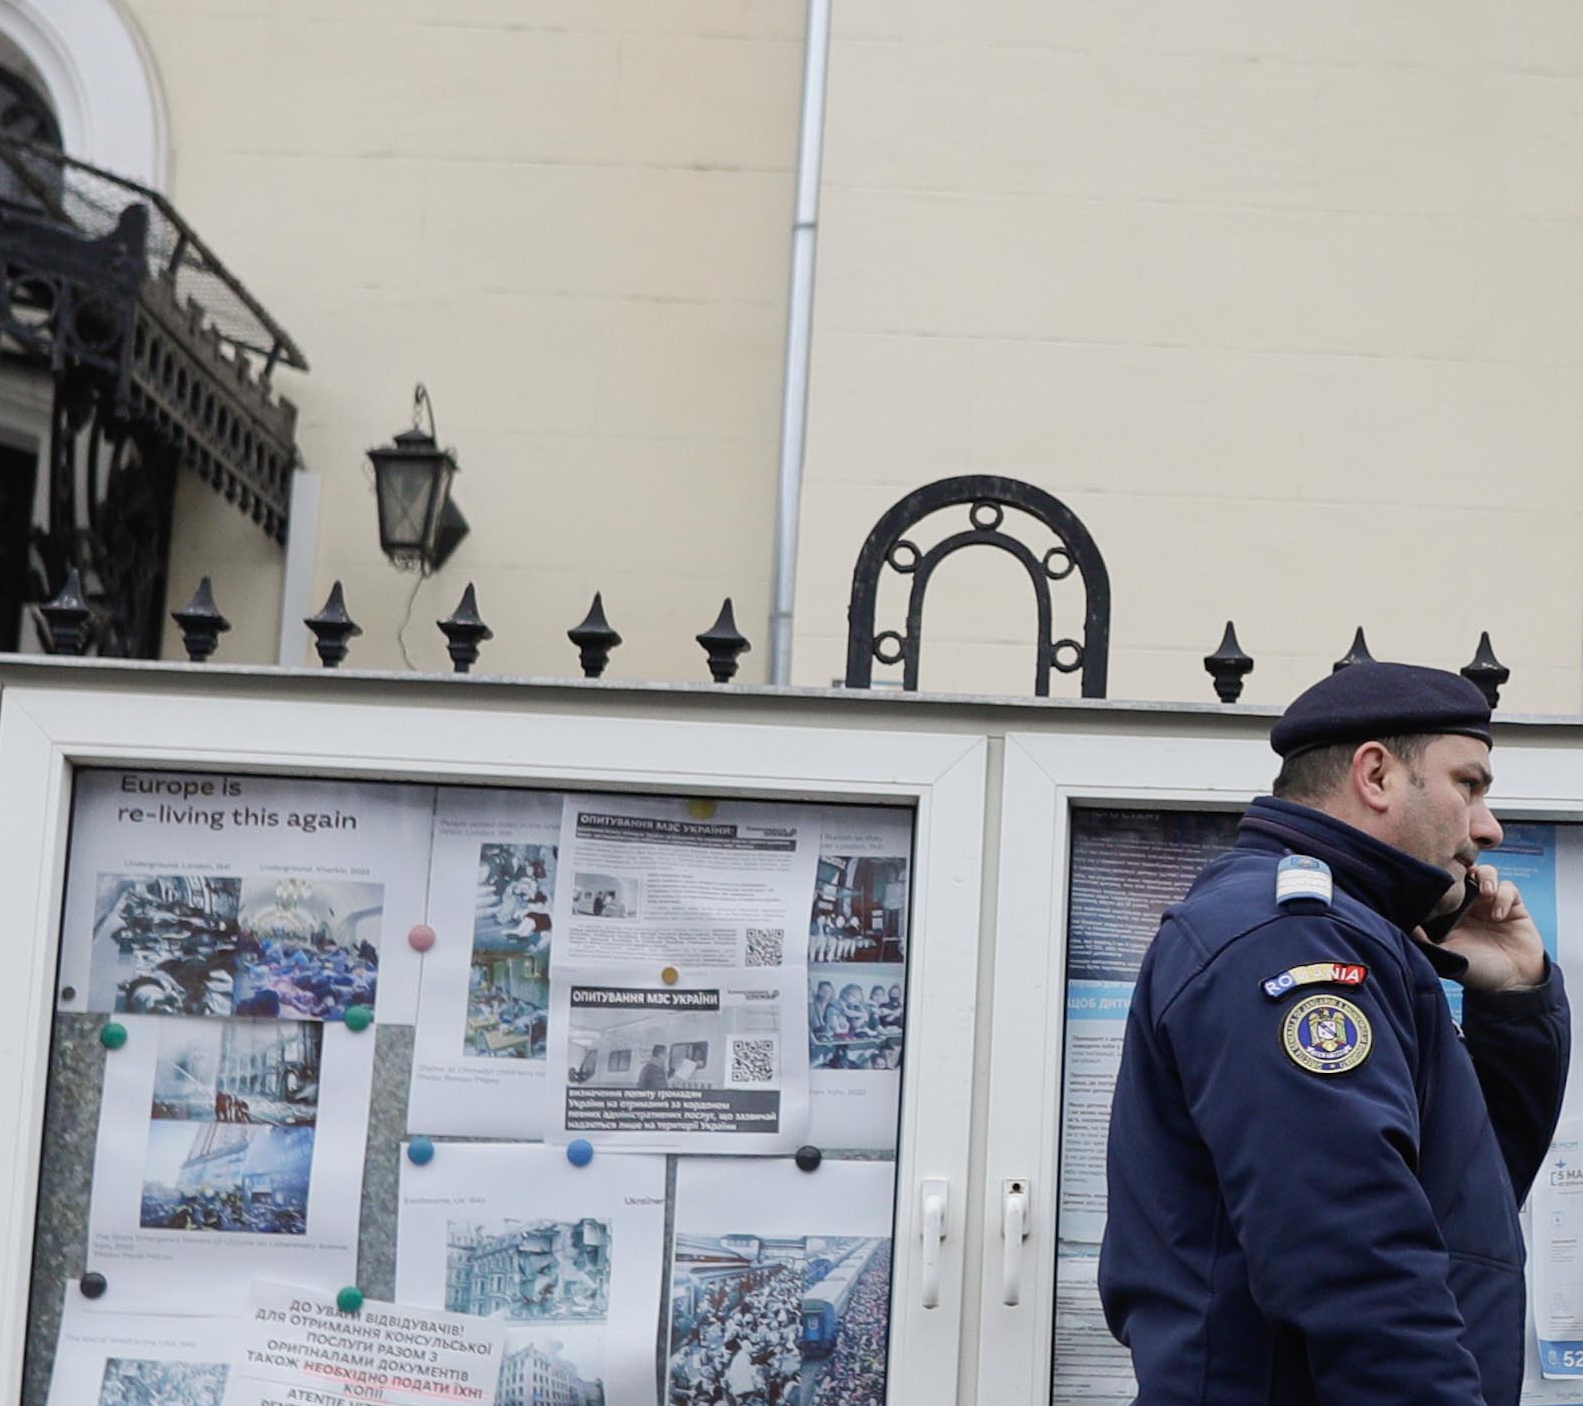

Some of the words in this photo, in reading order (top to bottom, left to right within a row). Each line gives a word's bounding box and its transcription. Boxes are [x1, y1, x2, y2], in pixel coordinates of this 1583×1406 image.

[121, 774, 215, 800] Europe
[222, 777, 243, 797] is
[118, 803, 225, 830] re-living
[232, 806, 280, 827] this
[287, 809, 358, 833] again
[573, 991, 645, 1005] ОПИТУВАННЯ
[647, 992, 671, 1005] МЗС
[672, 991, 718, 1005] УКРАЇНИ
[255, 1308, 286, 1324] ДЛЯ
[290, 1314, 381, 1340] ОТРИМАННЯ
[385, 1331, 492, 1356] КОНСУЛЬСЬКОЇ
[289, 1299, 312, 1313] ДО
[365, 1312, 465, 1337] ВІДВІДУВАЧІВ!
[266, 1340, 375, 1368] ОРИГІНАЛАМИ
[378, 1359, 469, 1383] ДОКУМЕНТІВ
[307, 1332, 373, 1353] ПОСЛУГИ
[377, 1344, 425, 1363] РАЗОМ
[247, 1350, 299, 1370] ТАКОЖ
[303, 1361, 388, 1386] НЕОБХІДНО
[392, 1376, 450, 1394] ПОДАТИ
[453, 1381, 483, 1400] ЇХНІ
[344, 1383, 383, 1400] КОПІЇ
